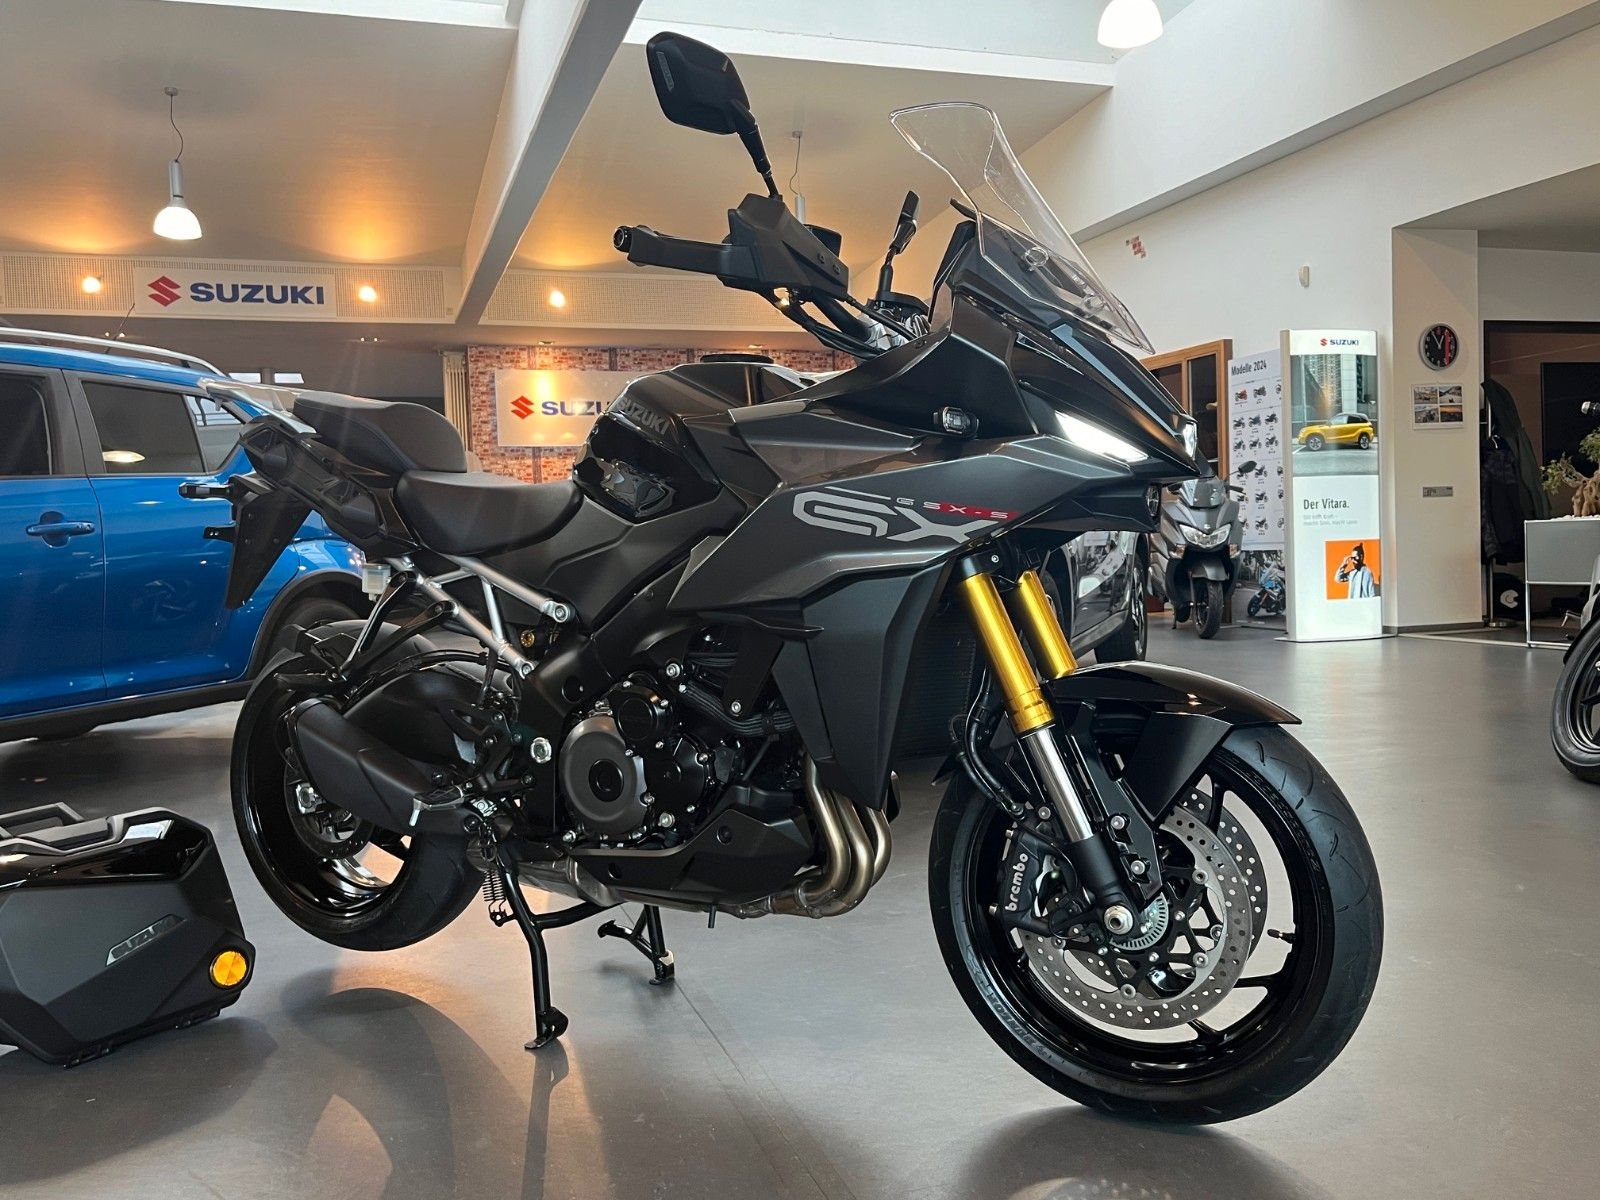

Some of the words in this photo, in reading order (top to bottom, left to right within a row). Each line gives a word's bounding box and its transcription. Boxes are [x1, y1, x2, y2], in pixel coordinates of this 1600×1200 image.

[190, 282, 325, 305] SUZUKI
[1231, 363, 1252, 376] Modelle
[1253, 360, 1267, 372] 2024
[617, 397, 671, 435] SUZUKI
[1303, 499, 1319, 510] Der
[1322, 498, 1350, 509] Vitara.
[1004, 853, 1029, 912] brembo
